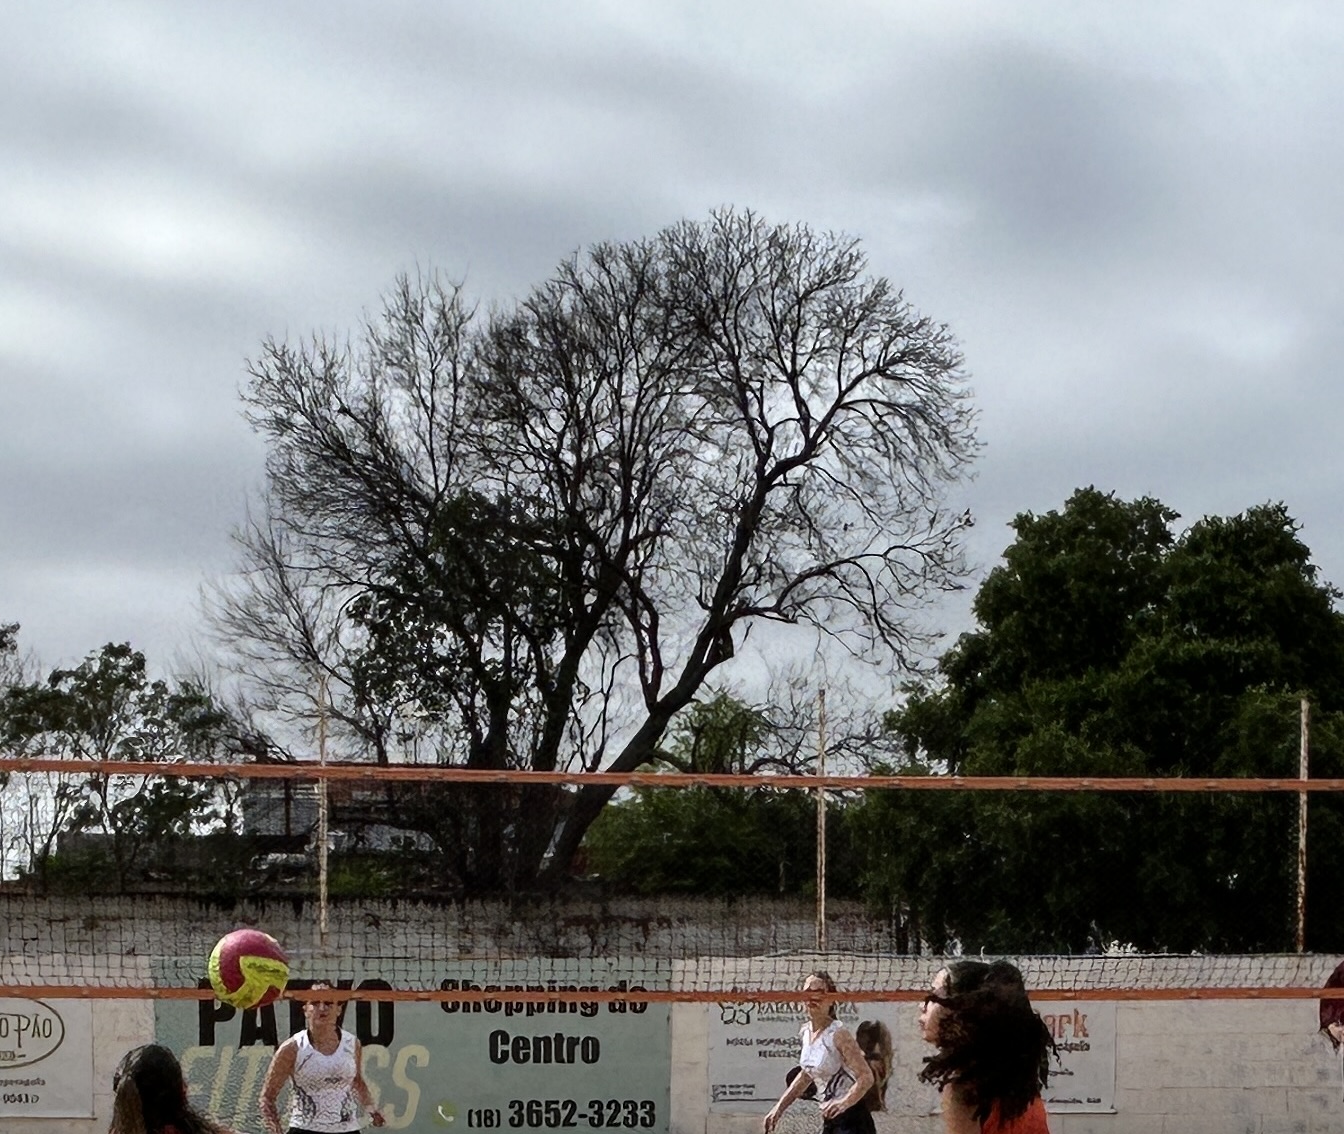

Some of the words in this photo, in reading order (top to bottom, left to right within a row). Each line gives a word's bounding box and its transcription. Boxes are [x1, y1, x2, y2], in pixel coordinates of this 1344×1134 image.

[441, 979, 599, 1017] Shopping
[608, 981, 649, 1014] do
[489, 1029, 600, 1065] Centro
[467, 1108, 502, 1129] (18)
[508, 1100, 656, 1128] 3652-3233
